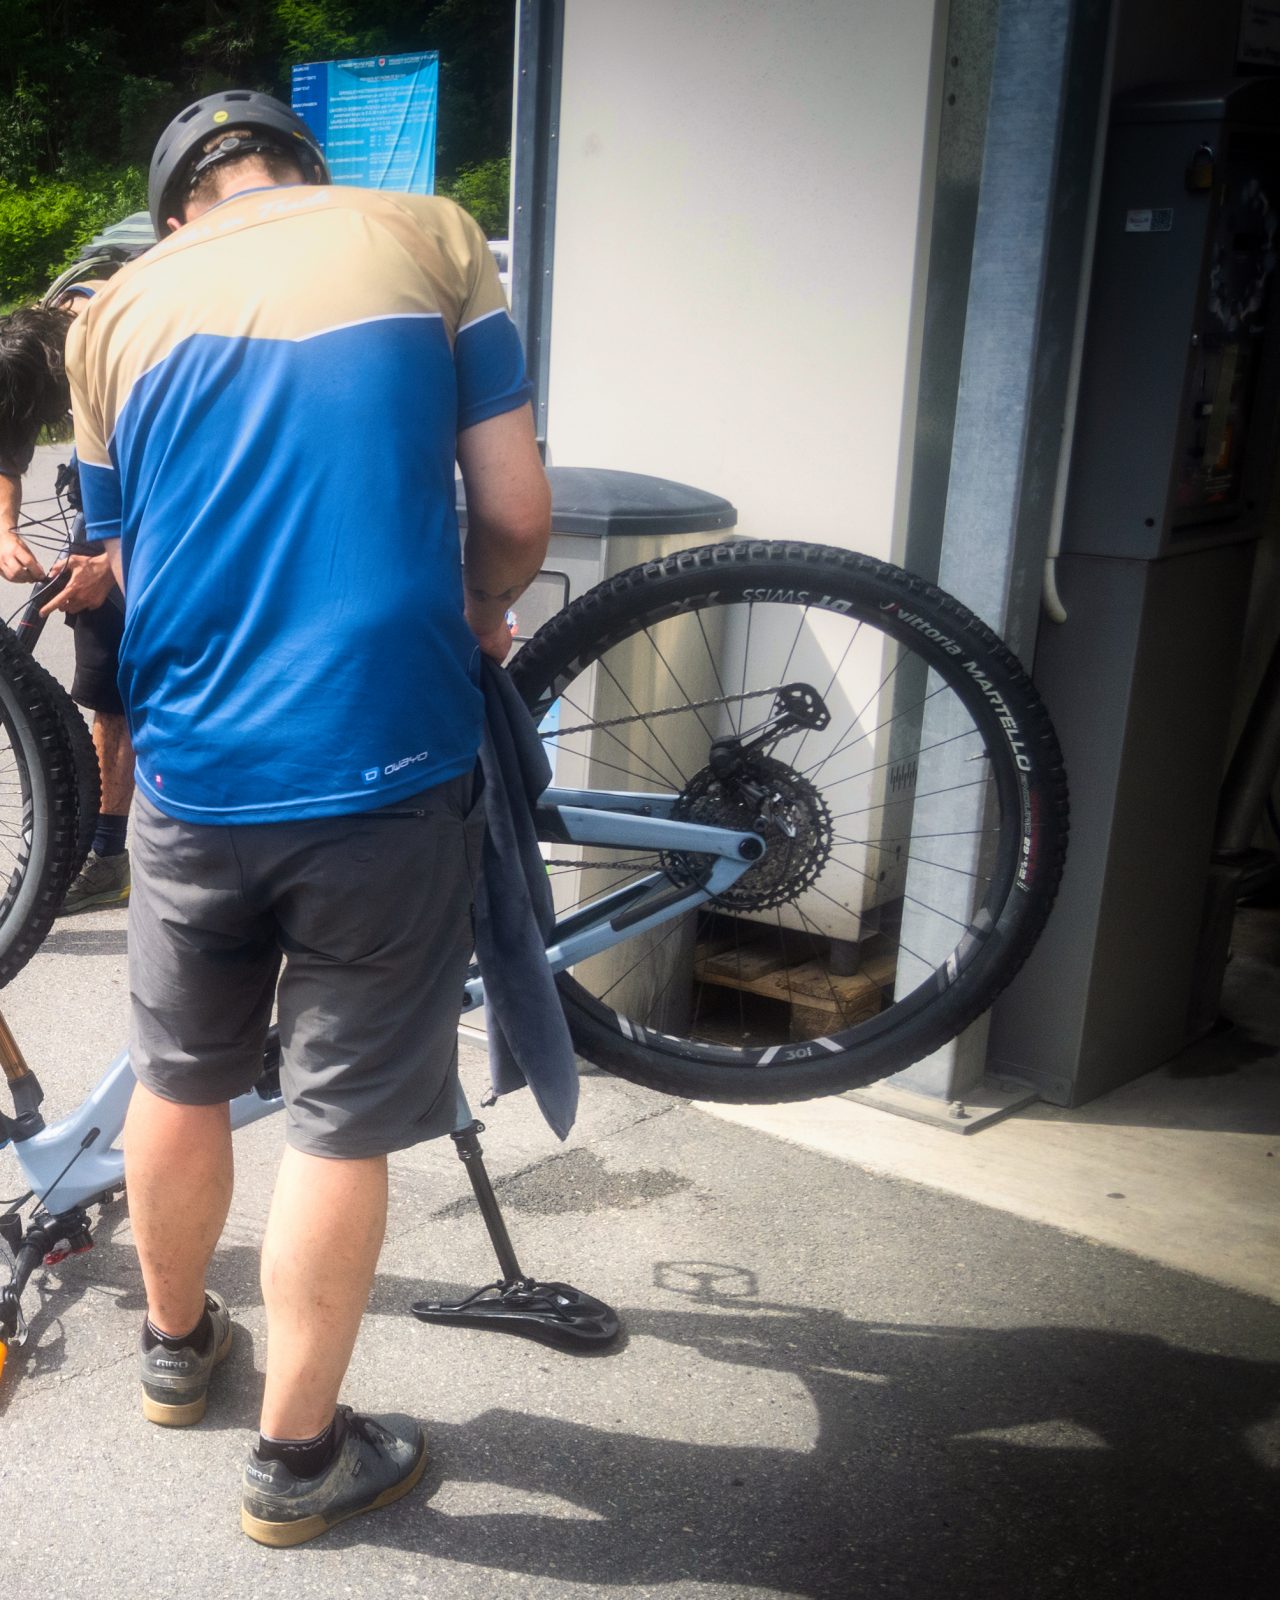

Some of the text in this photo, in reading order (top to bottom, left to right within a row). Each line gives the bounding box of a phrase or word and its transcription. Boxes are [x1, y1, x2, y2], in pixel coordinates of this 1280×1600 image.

[742, 588, 853, 613] DT SWISS
[896, 606, 1032, 772] vittoria MARTELLO
